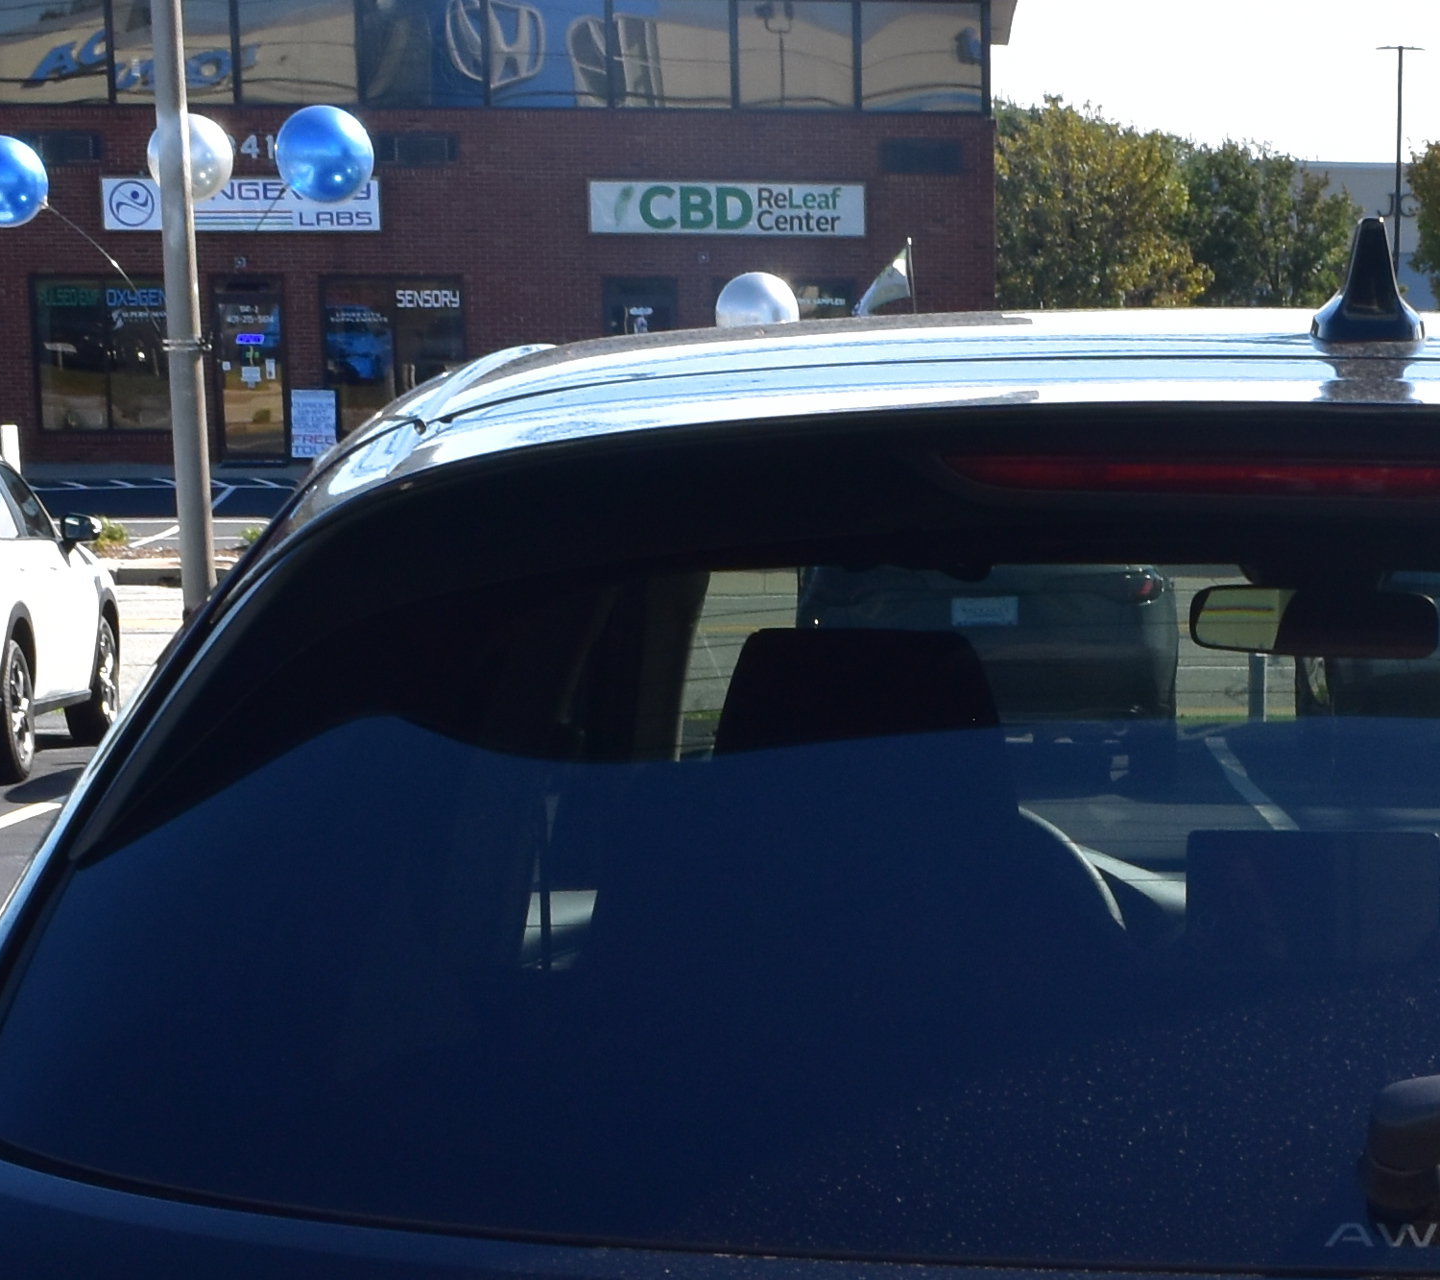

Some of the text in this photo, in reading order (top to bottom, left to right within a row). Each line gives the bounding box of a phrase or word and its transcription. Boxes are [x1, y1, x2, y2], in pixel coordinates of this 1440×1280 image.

[639, 185, 842, 230] CBD ReLeaf
[299, 211, 373, 227] LABS
[757, 210, 842, 233] Center
[395, 289, 460, 308] SENSORY
[291, 434, 336, 445] FREE
